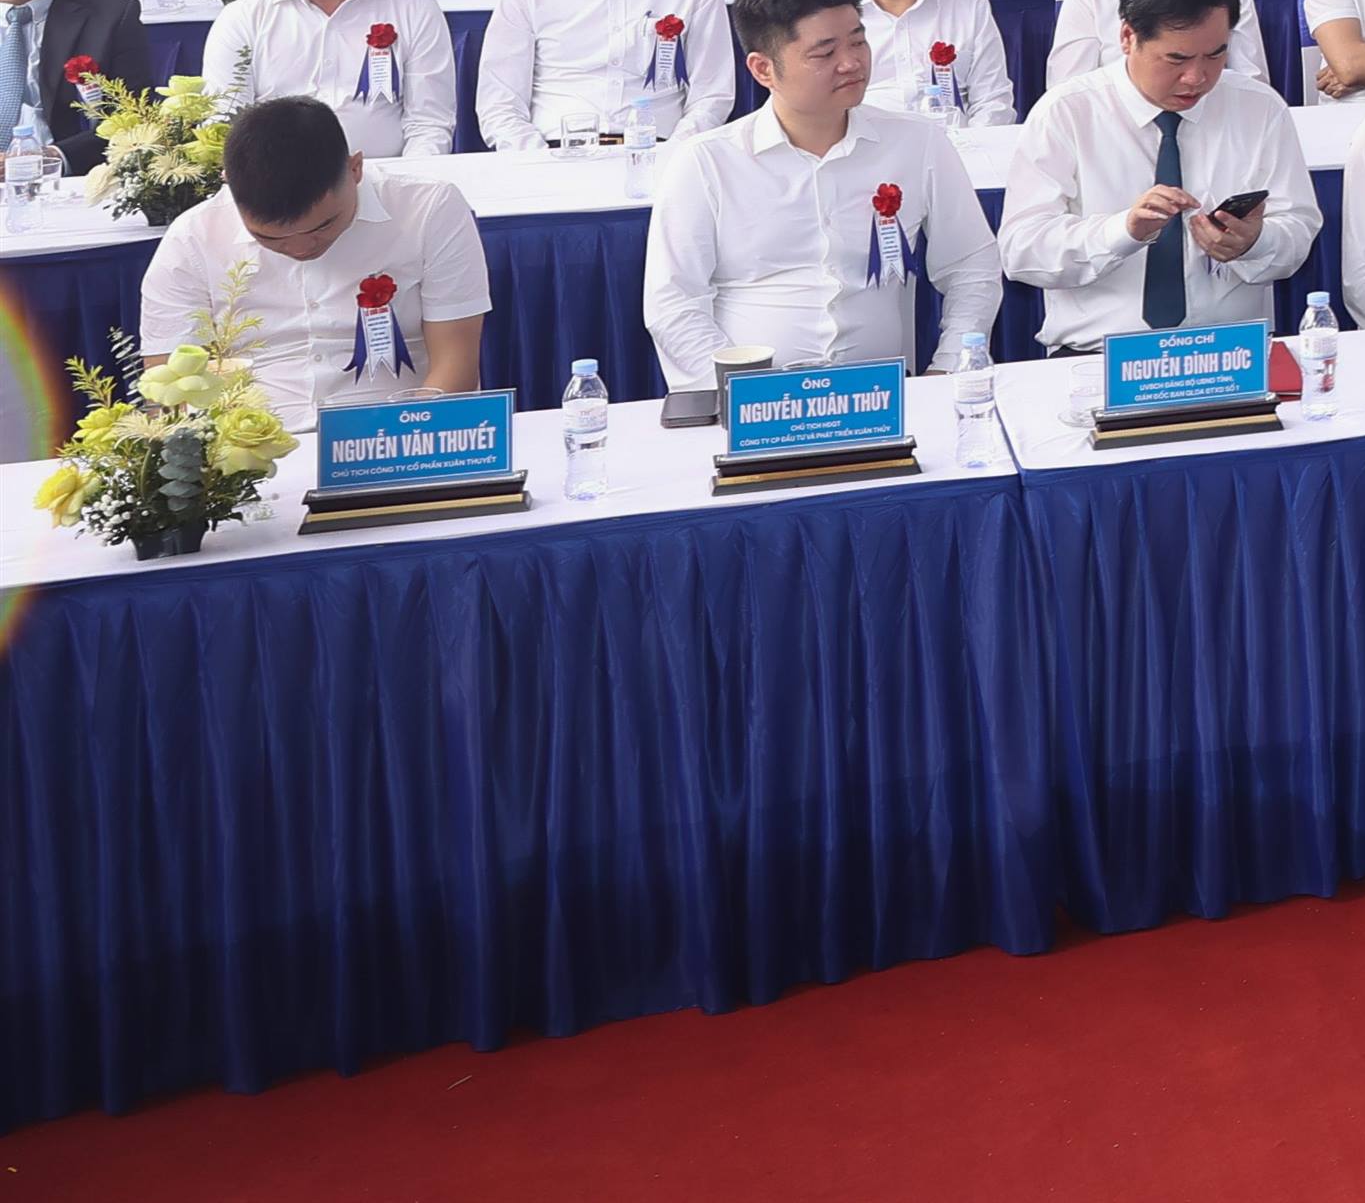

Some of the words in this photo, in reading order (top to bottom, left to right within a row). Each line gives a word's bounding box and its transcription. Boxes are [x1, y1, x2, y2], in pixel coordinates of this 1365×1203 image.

[1159, 334, 1193, 348] ĐỒNG
[1195, 332, 1216, 345] CHÍ
[1122, 351, 1180, 382] NGUYỄN
[1183, 350, 1219, 375] ĐÌNH
[1222, 346, 1252, 372] ĐỨC
[802, 377, 831, 389] ÔNG
[1134, 392, 1153, 402] GIÁM
[1154, 389, 1169, 400] ĐỐC
[1170, 390, 1185, 398] BAN
[1226, 382, 1236, 392] SỐ
[1165, 379, 1184, 388] ĐẢNG
[1185, 378, 1195, 387] BỘ
[740, 393, 802, 424] NGUYỄN
[807, 392, 849, 418] XUÂN
[853, 385, 891, 413] THỦY
[400, 410, 431, 423] ÔNG
[740, 437, 760, 447] CÔNG
[761, 437, 771, 445] TY
[772, 436, 781, 444] CP
[781, 433, 796, 443] ĐẦU
[797, 434, 806, 442] TƯ
[806, 432, 816, 440] VÀ
[816, 430, 833, 439] PHÁT
[834, 428, 853, 438] TRIỂN
[854, 426, 872, 436] XUÂN
[791, 422, 805, 432] CHỦ
[806, 422, 820, 431] TỊCH
[332, 429, 398, 464] NGUYỄN
[402, 429, 434, 457] VĂN
[438, 420, 496, 453] THUYẾT
[332, 469, 349, 479] CHỦ
[351, 468, 370, 478] TỊCH
[371, 465, 394, 475] CÔNG
[395, 465, 406, 473] TY
[407, 461, 420, 472] CỔ
[421, 460, 442, 470] PHẦN
[443, 458, 466, 468] XUÂN
[466, 454, 497, 466] THUYẾT
